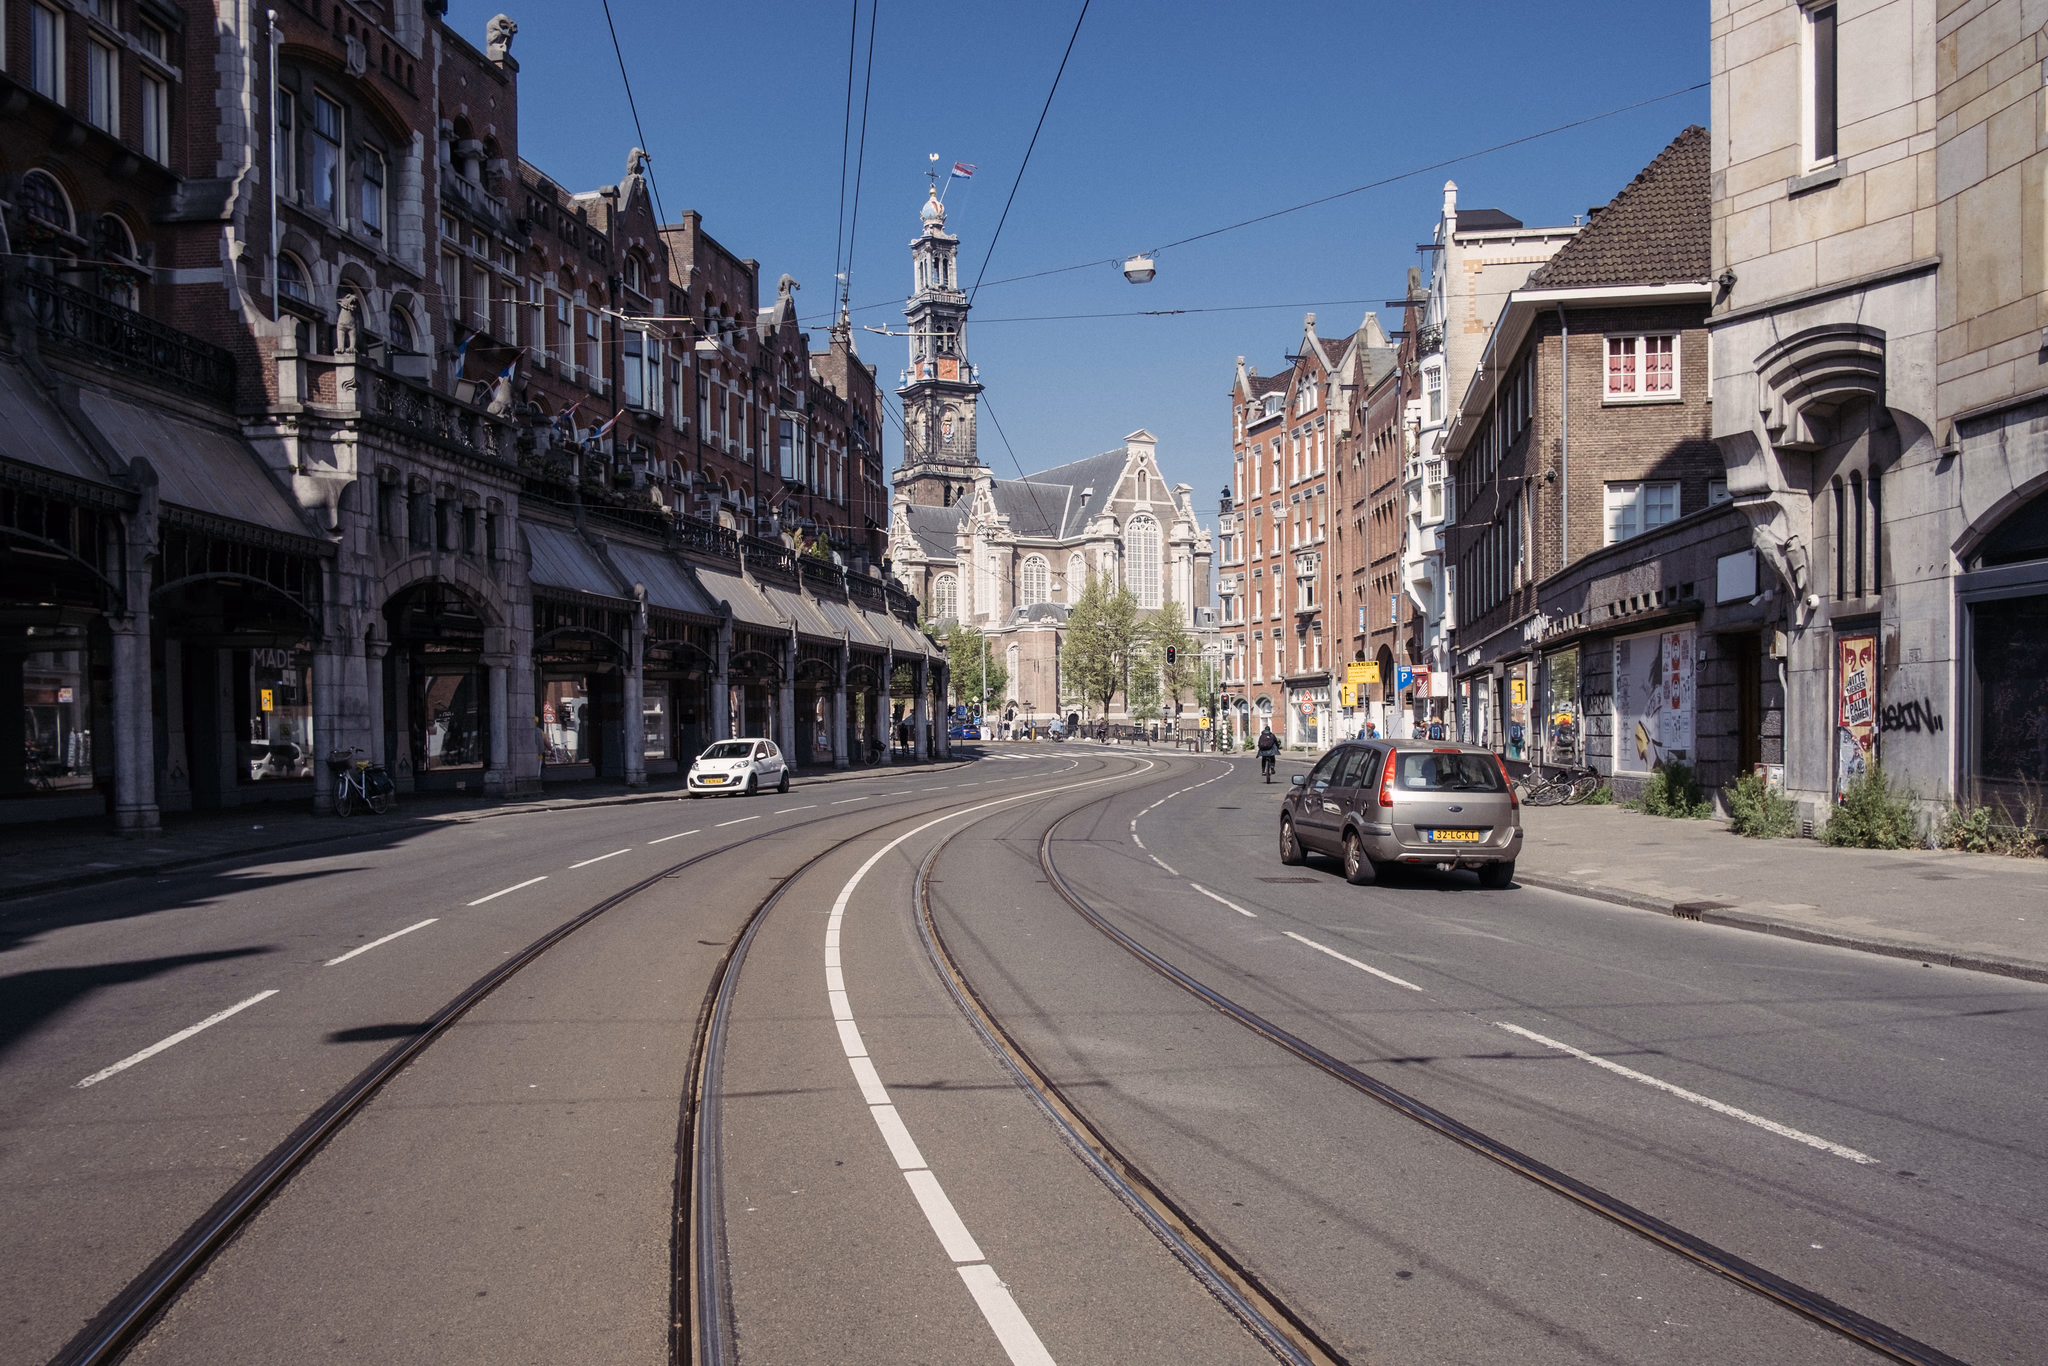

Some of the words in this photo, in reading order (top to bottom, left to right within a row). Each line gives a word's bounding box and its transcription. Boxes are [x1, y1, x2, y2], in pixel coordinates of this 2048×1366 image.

[1401, 672, 1408, 683] P
[1849, 698, 1869, 715] PALM
[1851, 709, 1870, 724] BOMEN
[1436, 830, 1476, 840] 32-LG-KT
